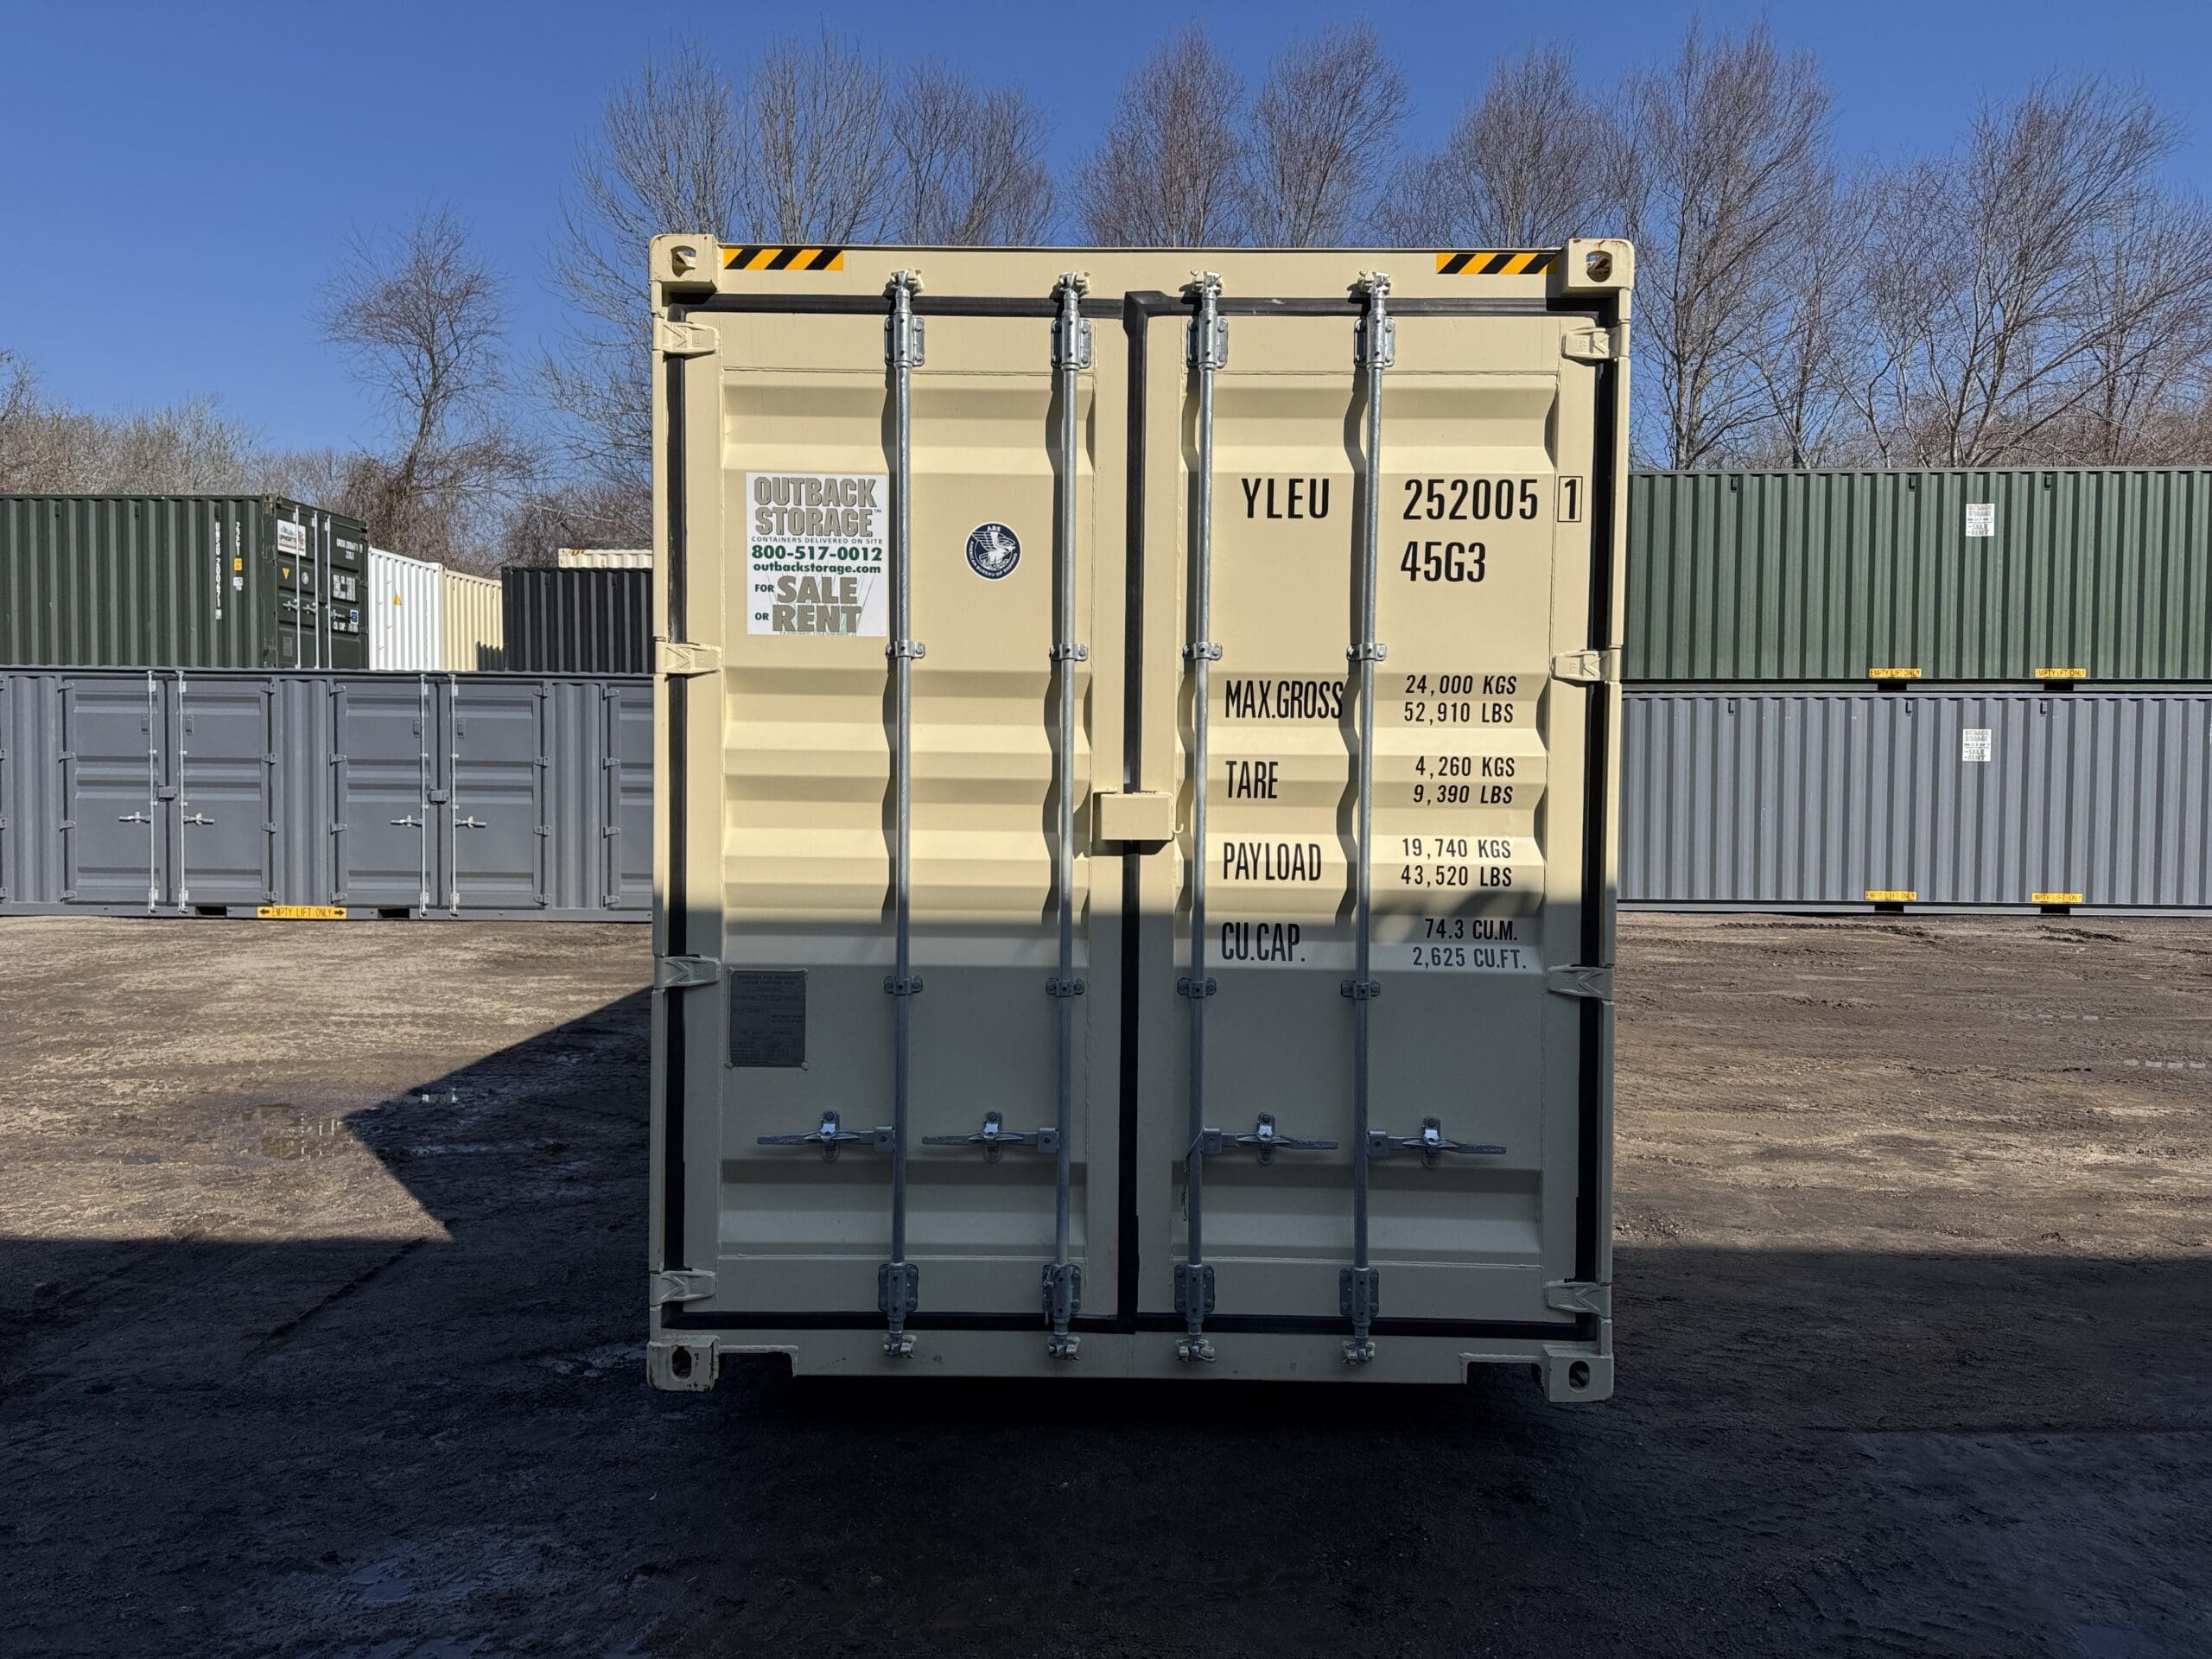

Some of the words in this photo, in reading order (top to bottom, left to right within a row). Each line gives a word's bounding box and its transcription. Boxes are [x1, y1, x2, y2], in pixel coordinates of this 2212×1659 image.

[753, 476, 878, 508] OUTBACK
[1241, 478, 1330, 519] YLEU
[1402, 478, 1539, 521] 252005
[1562, 479, 1578, 520] 1
[754, 506, 874, 537] STORAGE
[751, 544, 883, 562] 800-517-0012
[1400, 541, 1487, 582] 45G3
[753, 562, 881, 575] outbackstorage.com
[754, 583, 775, 593] FOR
[777, 575, 858, 604] SALE
[754, 612, 769, 620] OR
[772, 604, 862, 633] RENT
[1224, 679, 1344, 720] MAX.GROSS
[1405, 674, 1473, 698] 24,000
[1482, 675, 1518, 696] KGS
[1403, 702, 1469, 726] 52,910
[1481, 702, 1514, 723] LBS
[1225, 760, 1279, 799] TARE
[1414, 755, 1471, 779] 4,260
[1482, 756, 1516, 778] KGS
[1413, 784, 1470, 807] 9,390
[1480, 785, 1514, 804] LBS
[1223, 842, 1322, 881] PAYLOAD
[1402, 838, 1468, 861] 19,740
[1478, 839, 1512, 859] KGS
[1400, 865, 1469, 889] 43,520
[1479, 867, 1512, 887] LBS
[271, 906, 292, 917] EMPTY
[296, 907, 312, 918] LIFT
[315, 907, 332, 918] ONLY
[1221, 922, 1306, 963] CU.CAP.
[1425, 918, 1465, 940] 74.3
[1472, 919, 1518, 942] CU.M.
[1412, 946, 1465, 969] 2,625
[1473, 947, 1528, 970] CU.FT.
